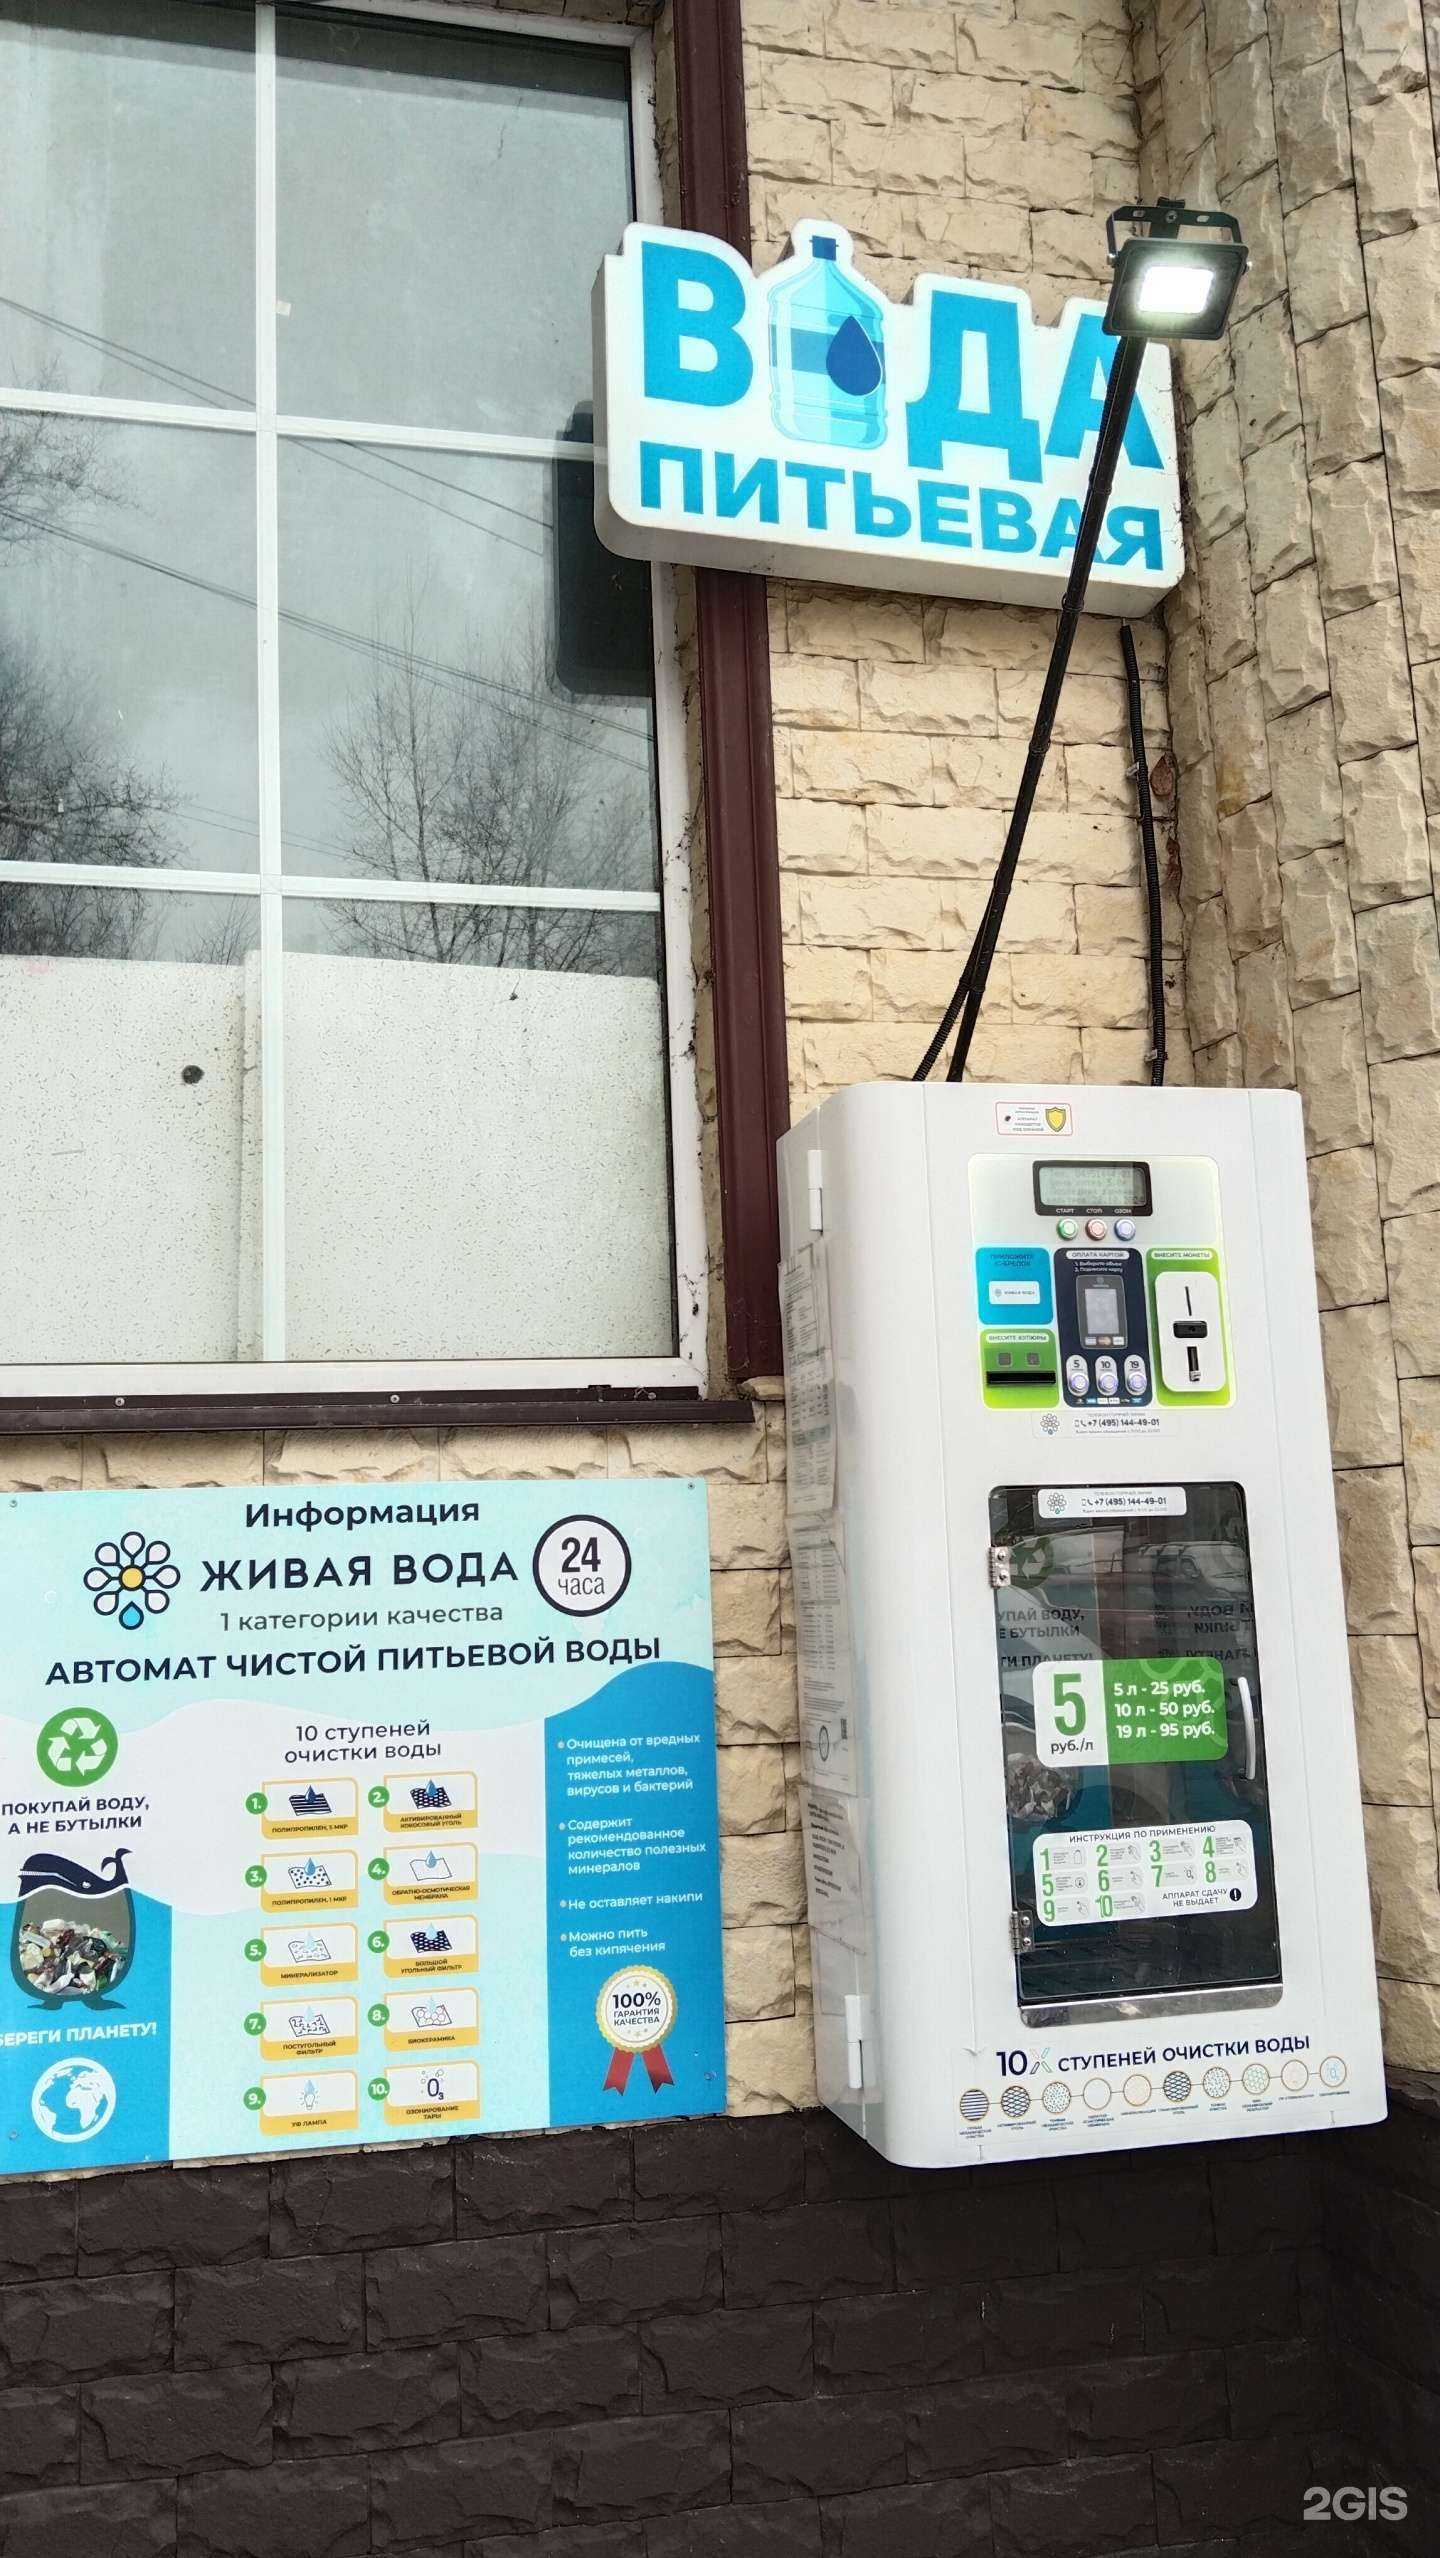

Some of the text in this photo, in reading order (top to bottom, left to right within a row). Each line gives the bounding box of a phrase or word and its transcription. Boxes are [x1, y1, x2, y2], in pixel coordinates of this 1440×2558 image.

[641, 240, 1165, 485] ВДА
[640, 440, 1164, 572] ПИТЬЕВАЯ
[1073, 1359, 1080, 1368] 5
[1101, 1360, 1110, 1368] 10
[1130, 1360, 1139, 1368] 19
[1098, 1419, 1119, 1428] (495)
[1121, 1418, 1160, 1426] 144-49-01
[1094, 1496, 1167, 1506] +7 (495) 144-49-01
[246, 1500, 480, 1532] Информация
[561, 1537, 602, 1573] 24
[200, 1551, 519, 1592] ЖИВАЯ ВОДА
[558, 1577, 605, 1597] часа
[220, 1605, 503, 1634] 1 категории качества
[1010, 1625, 1080, 1639] БУТЫЛКИ
[45, 1635, 660, 1686] АВТОМАТ ЧИСТОЙ ПИТЬЕВОЙ ВОДЫ
[1113, 1684, 1124, 1696] 5
[1126, 1685, 1137, 1696] л
[1151, 1681, 1169, 1695] 25
[1173, 1679, 1206, 1699] руб.
[1053, 1672, 1087, 1737] 5
[1115, 1703, 1131, 1718] 10
[1135, 1705, 1146, 1716] л
[1159, 1702, 1178, 1716] 50
[1183, 1700, 1216, 1720] руб.
[296, 1719, 431, 1743] 10 ступеней
[1116, 1724, 1132, 1738] 19
[1136, 1726, 1146, 1738] л
[1160, 1723, 1179, 1737] 95
[1183, 1720, 1216, 1741] руб.
[566, 1734, 701, 1751] Очищена от вредных
[1051, 1737, 1094, 1755] руб./л
[284, 1743, 441, 1763] очистки воды
[567, 1751, 634, 1768] примесей,
[568, 1766, 688, 1781] тяжелых металлов,
[372, 1791, 386, 1803] 2.
[567, 1779, 693, 1798] вирусов и бактерий
[1, 1796, 150, 1816] ПОКУПАЙ ВОДУ,
[251, 1797, 263, 1810] 1.
[8, 1815, 142, 1835] А НЕ БУТЫЛКИ
[568, 1817, 633, 1832] Содержит
[568, 1828, 686, 1846] рекомендованное
[1069, 1825, 1216, 1843] ИНСТРУКЦИЯ ПО ПРИМЕНЕНИЮ
[568, 1843, 707, 1860] количество полезных
[1096, 1844, 1108, 1867] 2
[1149, 1840, 1161, 1862] 3
[1202, 1835, 1215, 1858] 4
[568, 1861, 641, 1876] минералов
[1040, 1848, 1050, 1871] 1
[250, 1870, 263, 1883] 3.
[371, 1863, 387, 1875] 4.
[1151, 1865, 1163, 1888] 7
[1205, 1860, 1217, 1883] 8
[1042, 1874, 1054, 1897] 5
[1098, 1869, 1110, 1892] 6
[568, 1892, 704, 1910] Не оставляет накипи
[1162, 1888, 1228, 1901] АППАРАТ СДАЧУ
[1173, 1897, 1218, 1907] НЕ ВЫДАЕТ
[1043, 1899, 1055, 1922] 9
[1096, 1895, 1113, 1918] 10
[372, 1936, 385, 1948] 6.
[569, 1928, 649, 1942] Можно пить
[250, 1944, 262, 1956] 5.
[569, 1942, 666, 1958] без кипячения
[280, 1970, 339, 1979] МИНЕРАЛИЗАТОР
[612, 1991, 661, 2009] 100%
[372, 2010, 385, 2021] 8.
[613, 2008, 660, 2018] ГАРАНТИЯ
[613, 2016, 660, 2026] КАЧЕСТВА
[66, 2022, 157, 2042] ПЛАНЕТУ!
[250, 2018, 262, 2030] 7.
[282, 2040, 336, 2050] ПОСТУГОЛЬНЫЙ
[1058, 2035, 1310, 2072] СТУПЕНЕЙ ОЧИСТКИ ВОДЫ
[370, 2083, 388, 2095] 10.
[249, 2093, 262, 2105] 9.
[303, 2119, 327, 2127] ЛАМПА
